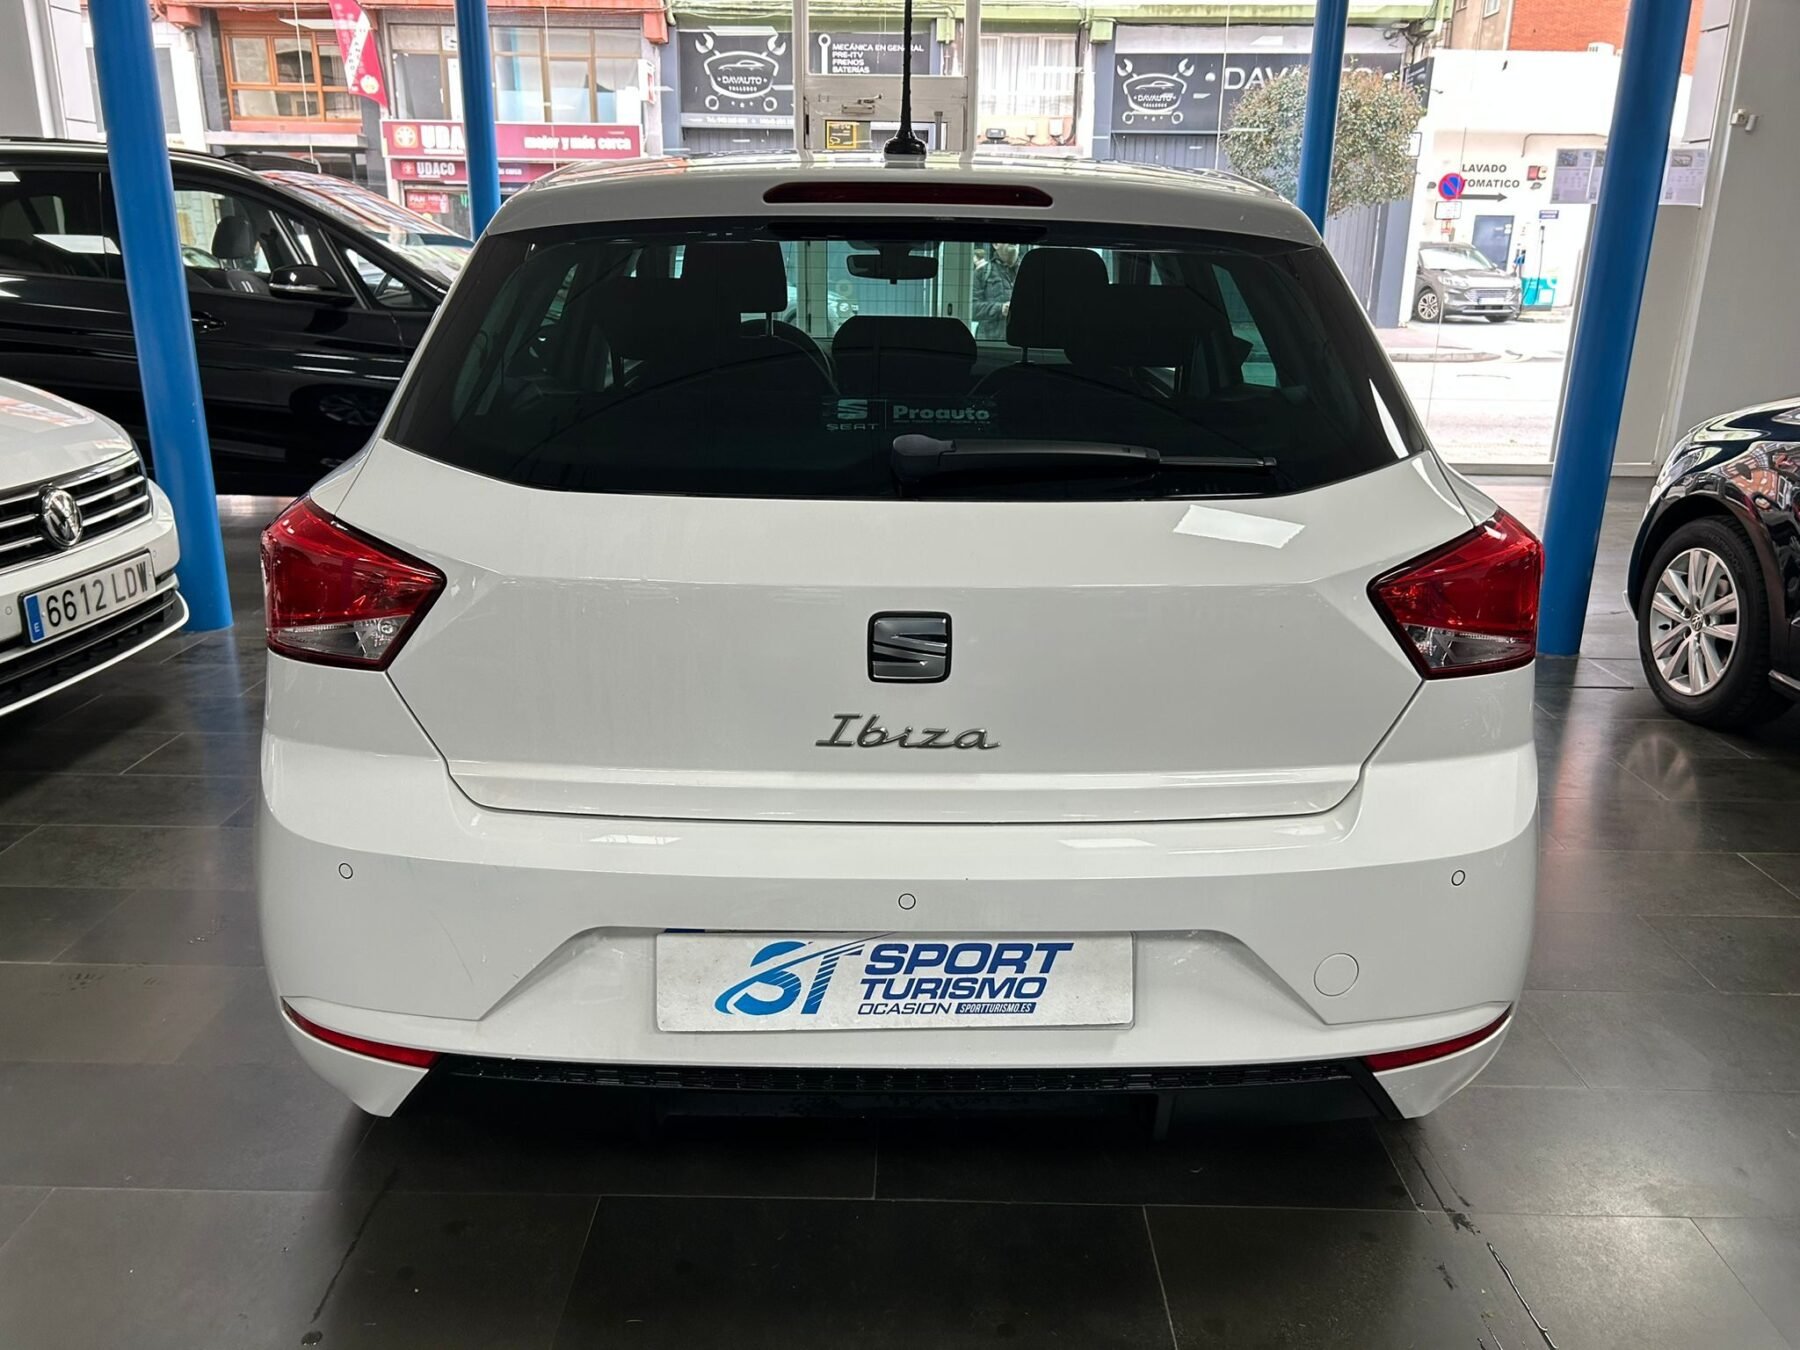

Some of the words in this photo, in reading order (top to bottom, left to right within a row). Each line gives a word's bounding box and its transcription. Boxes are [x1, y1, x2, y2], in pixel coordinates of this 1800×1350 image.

[832, 43, 874, 51] MECÁNICA
[887, 44, 924, 52] GENRAL
[832, 58, 865, 66] FRENOS
[832, 65, 870, 73] BATERÍAS
[722, 75, 762, 85] DAVAUTO
[1137, 94, 1173, 102] DAVAUTO
[420, 125, 465, 149] UDA
[524, 135, 559, 150] mejor
[597, 137, 632, 150] cerca
[416, 161, 456, 176] UDACO
[1461, 163, 1507, 173] LAVADO
[892, 405, 990, 420] Proauto
[825, 423, 879, 431] SEAT
[34, 622, 40, 633] E
[46, 578, 108, 628] 6612
[111, 560, 149, 604] LDW
[815, 713, 1001, 750] Ibiza
[864, 942, 1075, 975] SPORT
[859, 976, 1048, 1001] TURISMO
[857, 1002, 954, 1015] OCASION
[958, 1002, 1032, 1015] SPORTTURISMO.ES
